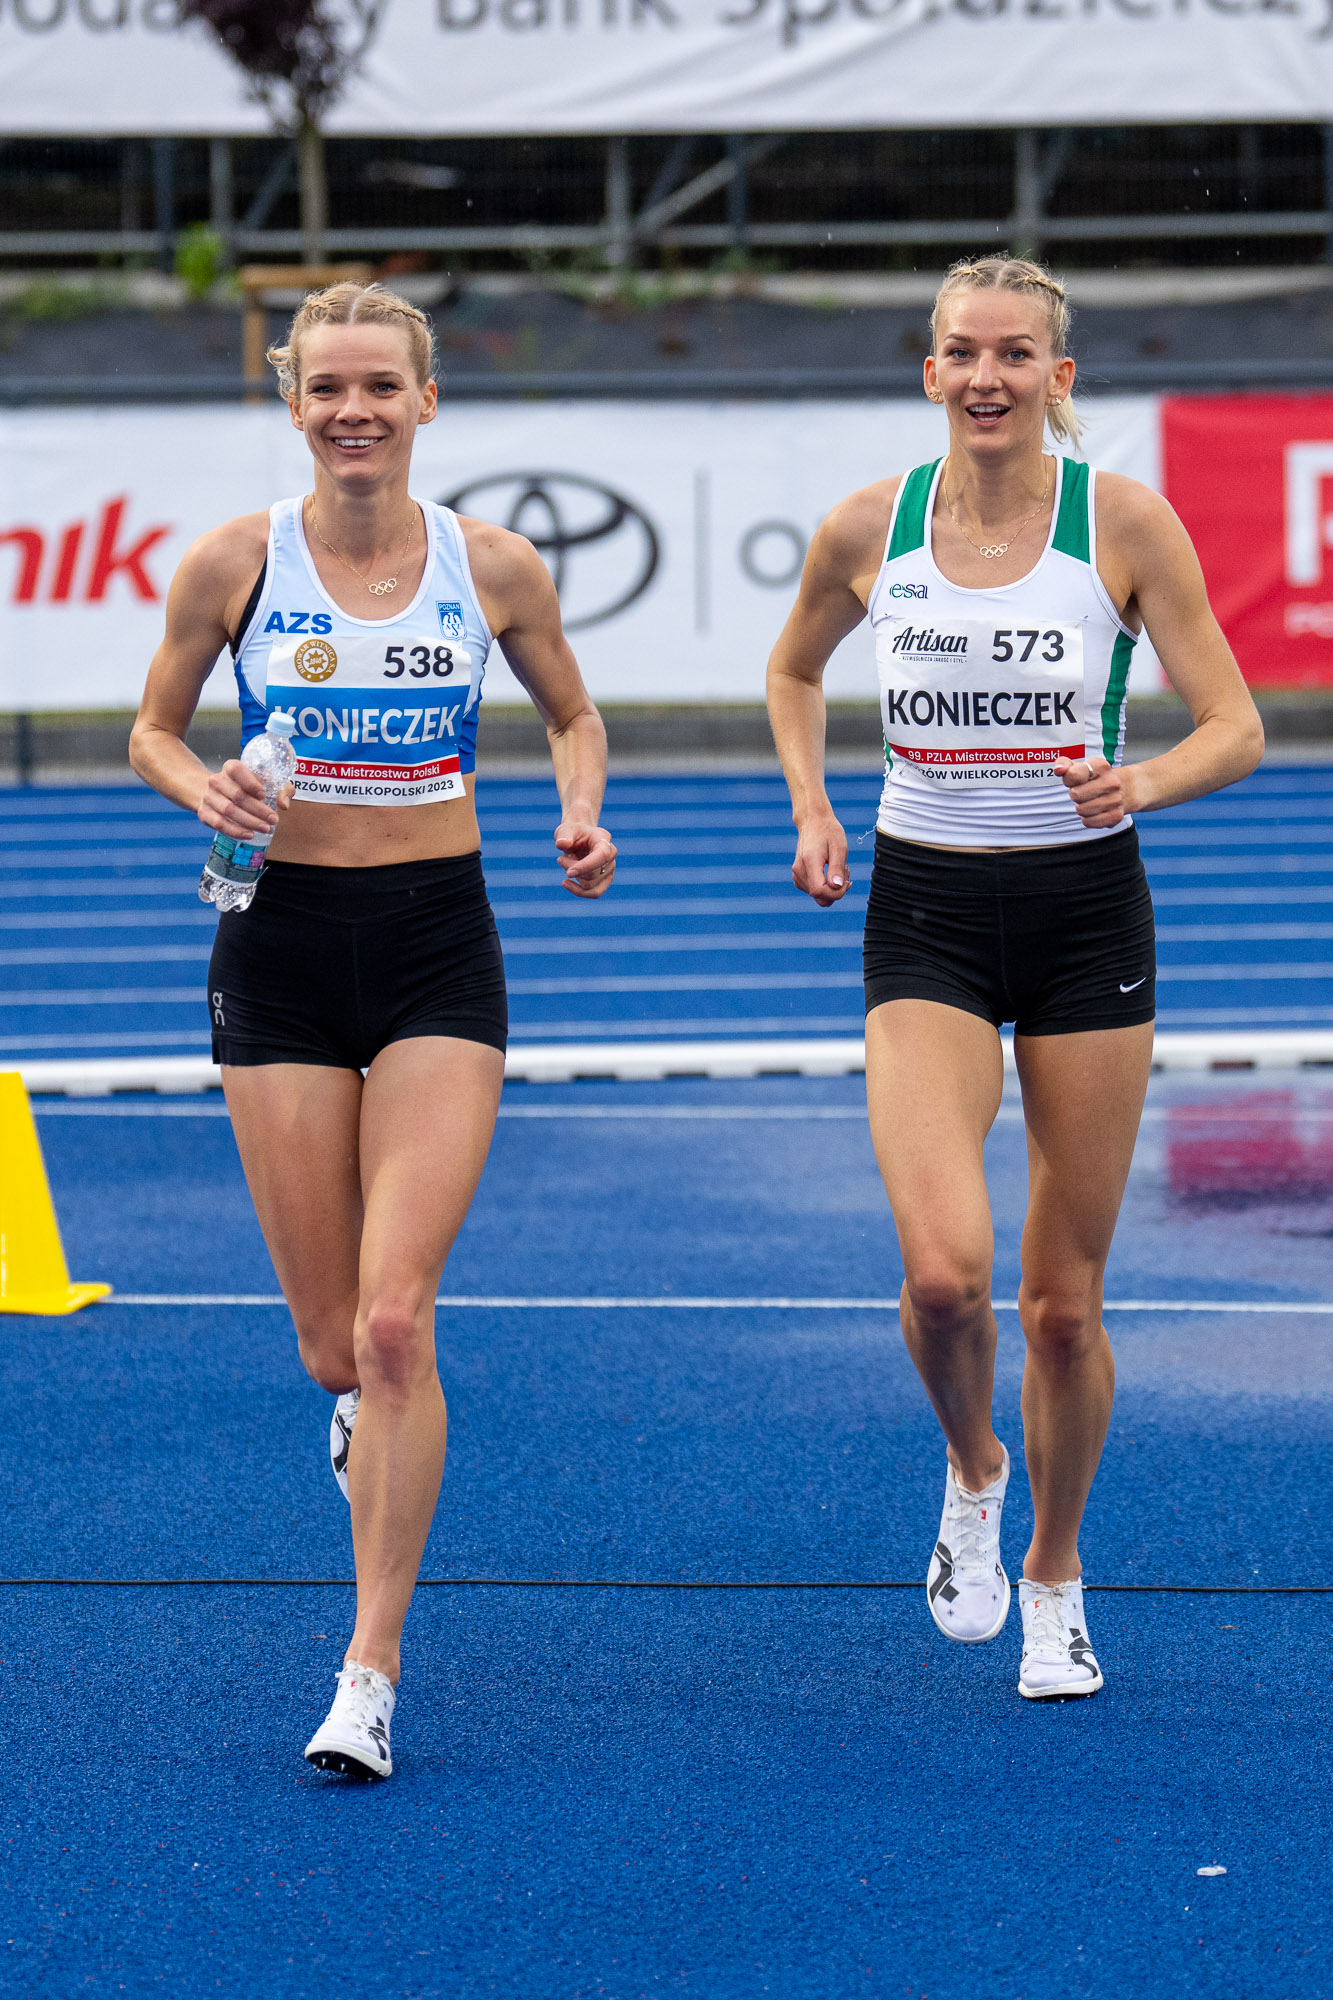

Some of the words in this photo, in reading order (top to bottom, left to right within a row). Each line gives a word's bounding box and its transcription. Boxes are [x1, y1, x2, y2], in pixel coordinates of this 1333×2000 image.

[264, 611, 333, 635] AZS
[892, 626, 968, 653] Artisan
[991, 630, 1065, 662] 573
[383, 646, 454, 678] 538
[888, 689, 1078, 727] KONIECZEK
[908, 751, 924, 761] 99.
[926, 752, 953, 762] PZLA
[955, 751, 1024, 762] Mistrzostwa
[1027, 750, 1060, 761] Polski
[311, 764, 338, 776] PZLA
[340, 766, 410, 779] Mistrzostwa
[413, 764, 440, 779] Polski
[951, 769, 1044, 779] WIELKOPOLSKI
[335, 784, 425, 797] WIELKOPOLSKI
[427, 780, 454, 793] 2023
